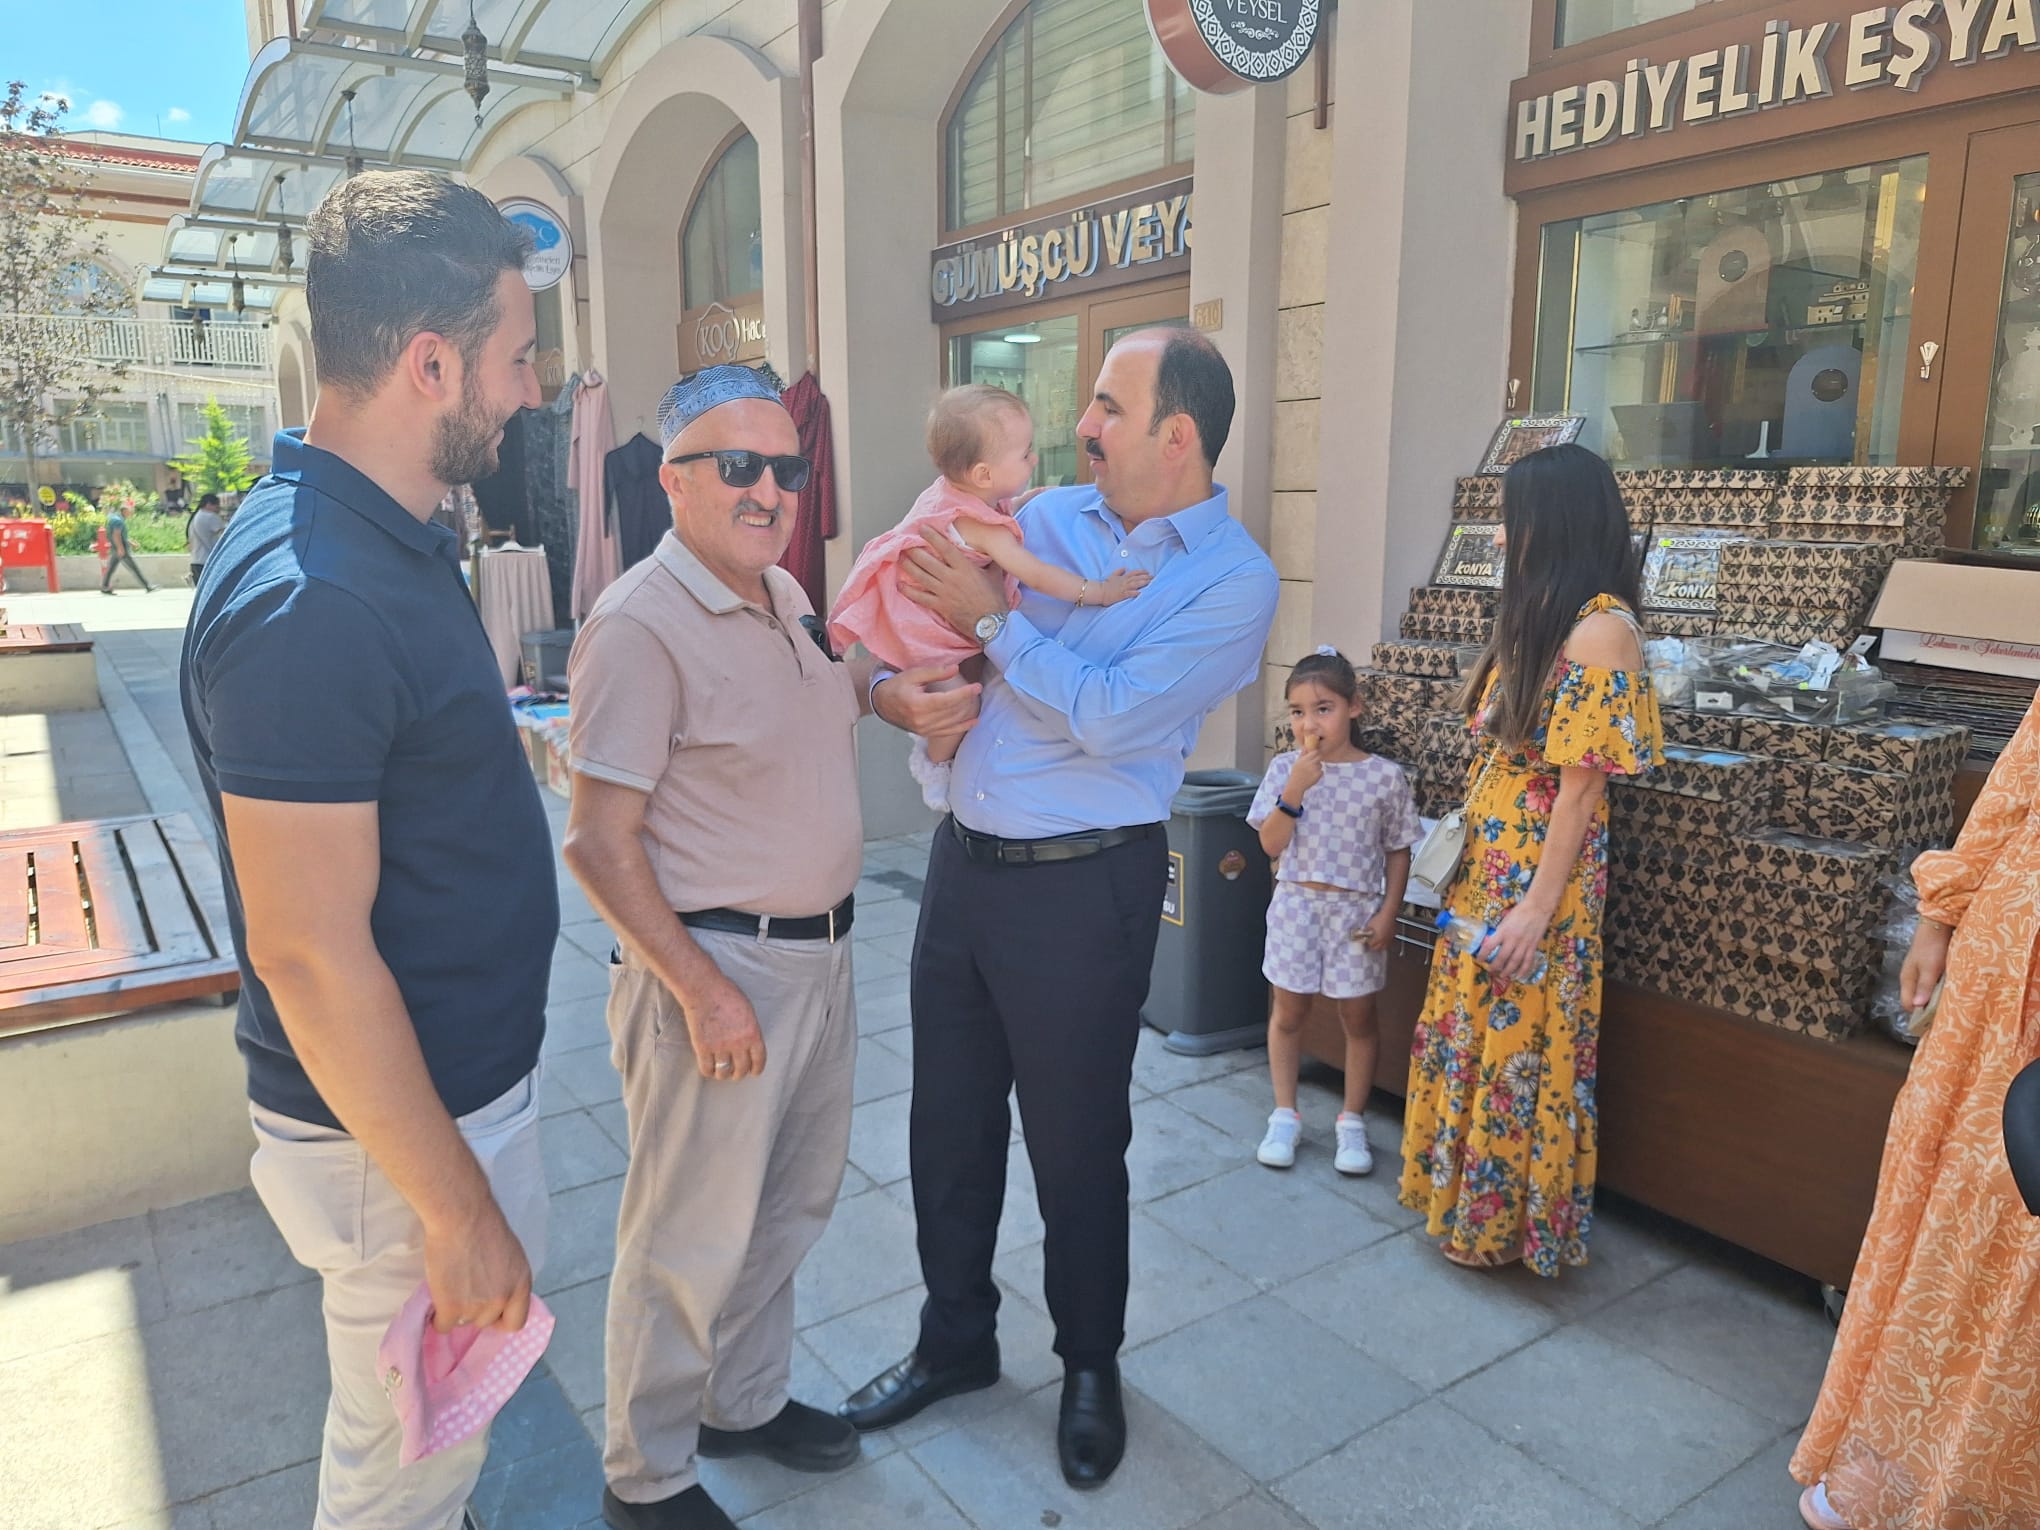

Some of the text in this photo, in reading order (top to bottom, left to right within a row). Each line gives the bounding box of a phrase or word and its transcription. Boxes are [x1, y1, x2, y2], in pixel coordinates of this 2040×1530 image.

[1226, 0, 1288, 24] VEYSEL
[1514, 0, 2040, 162] HEDİYELİK EŞYA
[932, 210, 1096, 305] GÜMÜŞCÜ
